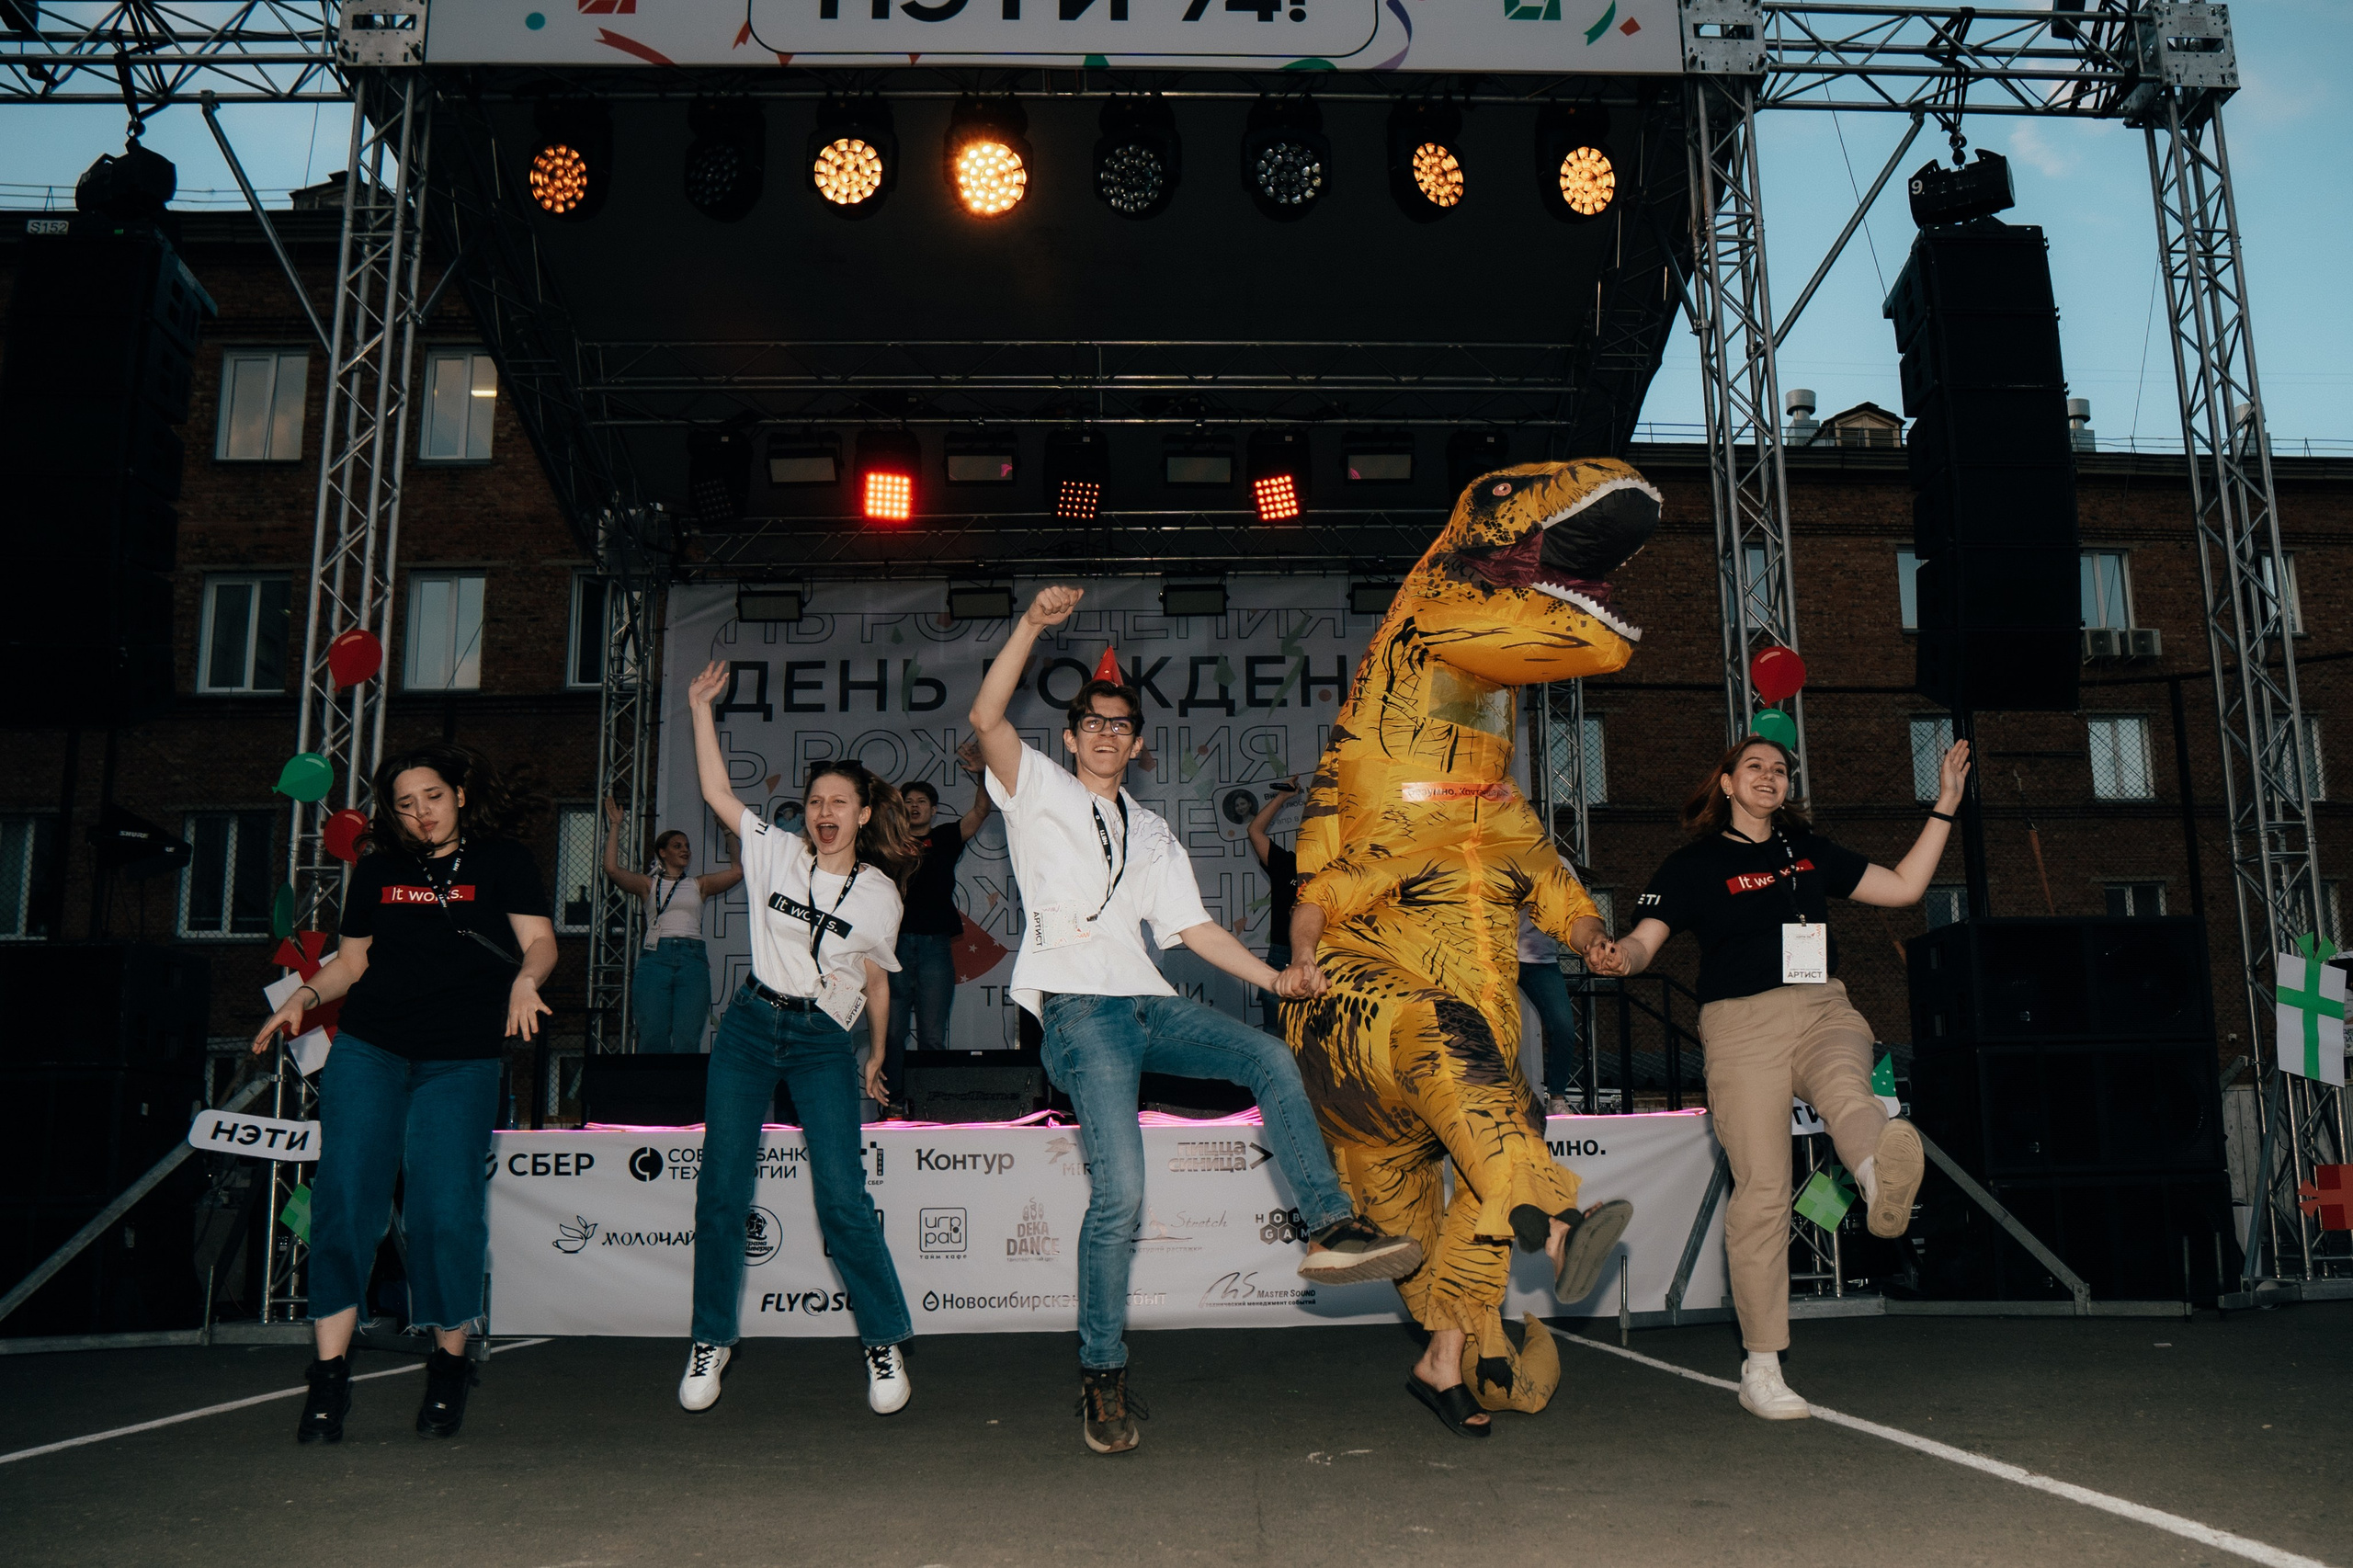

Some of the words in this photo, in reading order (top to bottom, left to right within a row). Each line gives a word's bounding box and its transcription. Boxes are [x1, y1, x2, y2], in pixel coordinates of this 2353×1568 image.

[29, 221, 68, 234] S152
[860, 608, 1347, 650] РОДЕИЯ
[715, 658, 948, 722] ДЕНЬ
[982, 654, 1348, 718] ОЖДЕН
[119, 830, 149, 839] SHURE
[1738, 876, 1753, 889] It
[1754, 866, 1804, 886] wok.
[392, 887, 404, 902] It
[409, 889, 463, 903] wos.
[774, 895, 789, 912] It
[790, 905, 838, 932] wos.
[1033, 911, 1042, 947] АРТИСТ
[1788, 971, 1823, 979] АРТИСТ
[846, 995, 863, 1027] АРТИСТ
[210, 1119, 311, 1152] НЭТИ
[508, 1153, 595, 1176] СБЕР
[668, 1148, 808, 1163] СОБАНК
[915, 1148, 1015, 1176] Контур
[1170, 1210, 1228, 1229] Stretch
[1256, 1213, 1301, 1224] HOB
[1017, 1221, 1049, 1238] DEKA
[1265, 1228, 1311, 1239] GAM
[1006, 1236, 1060, 1256] DANCE
[760, 1292, 801, 1312] FLY
[831, 1291, 855, 1312] SU
[942, 1290, 1167, 1312] Новосибирскэсбыт
[1256, 1290, 1289, 1299] MASTER
[1290, 1289, 1316, 1297] SOUND
